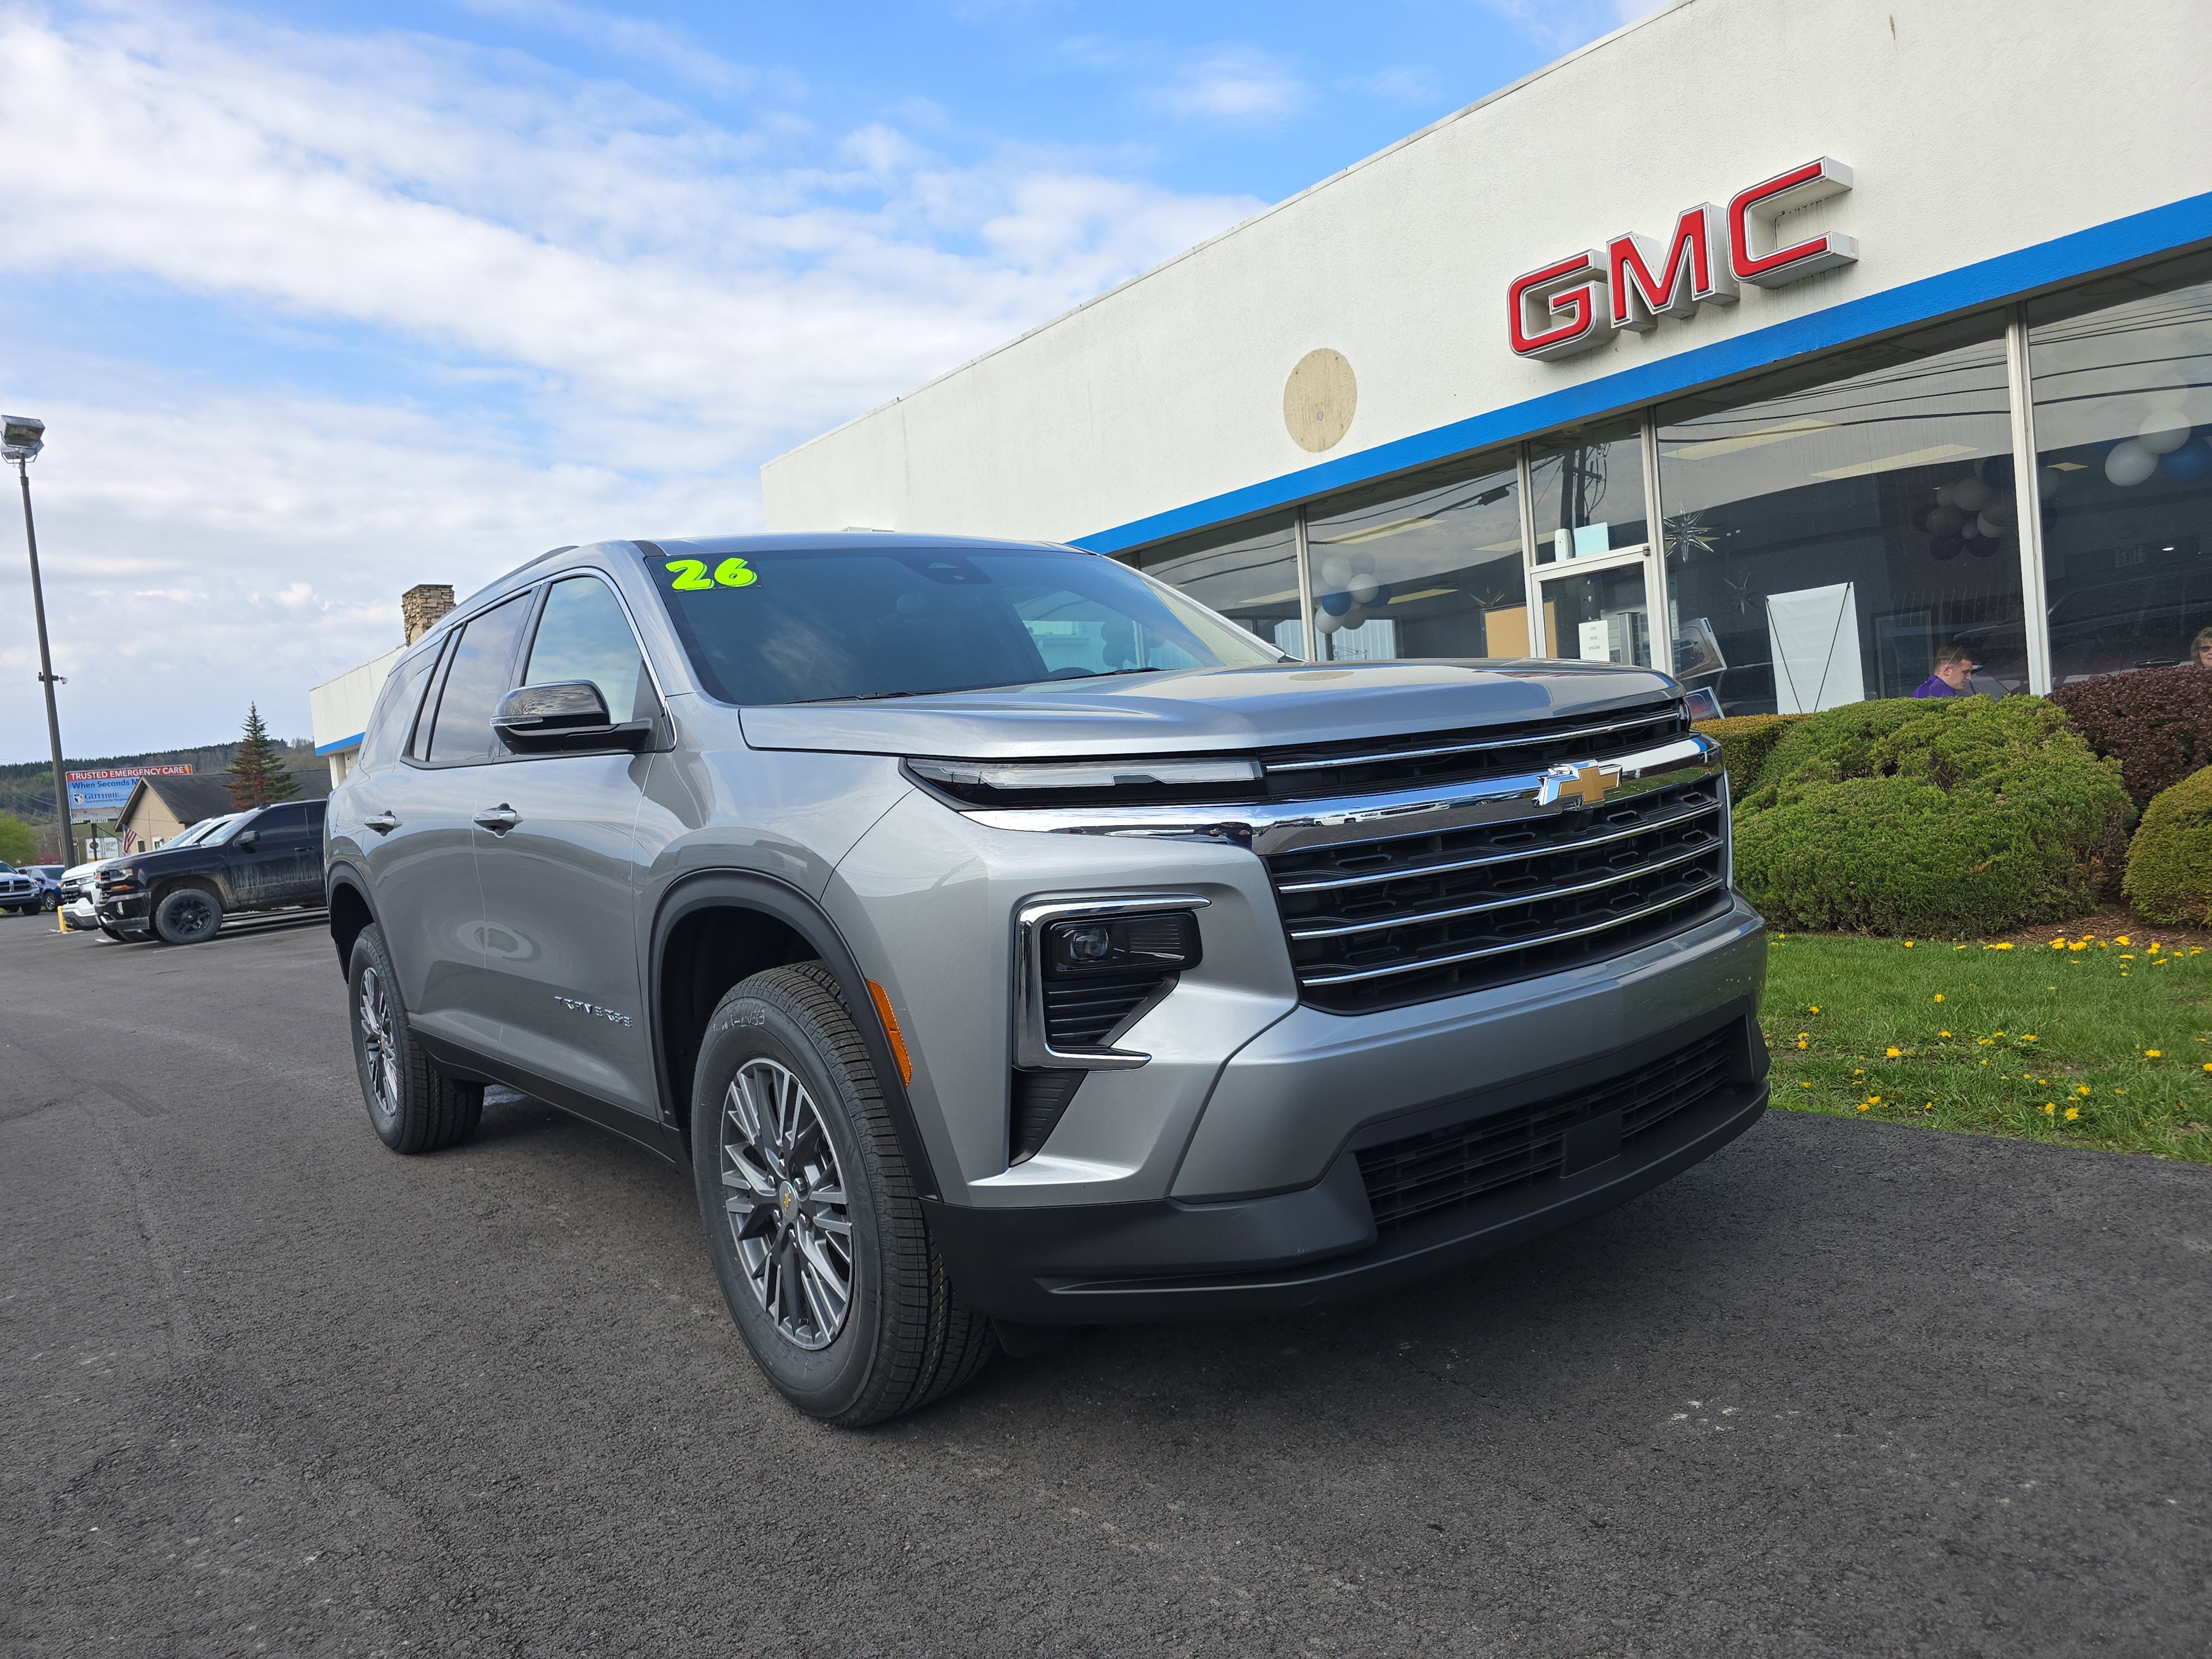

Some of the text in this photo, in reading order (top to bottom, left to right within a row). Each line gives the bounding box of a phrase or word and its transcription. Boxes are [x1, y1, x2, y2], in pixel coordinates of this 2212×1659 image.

[1507, 156, 1859, 362] GMC
[665, 557, 757, 591] 26
[71, 766, 184, 780] TRUSTED EMERGENCY CARE
[72, 781, 95, 789] When
[98, 778, 130, 787] Seconds
